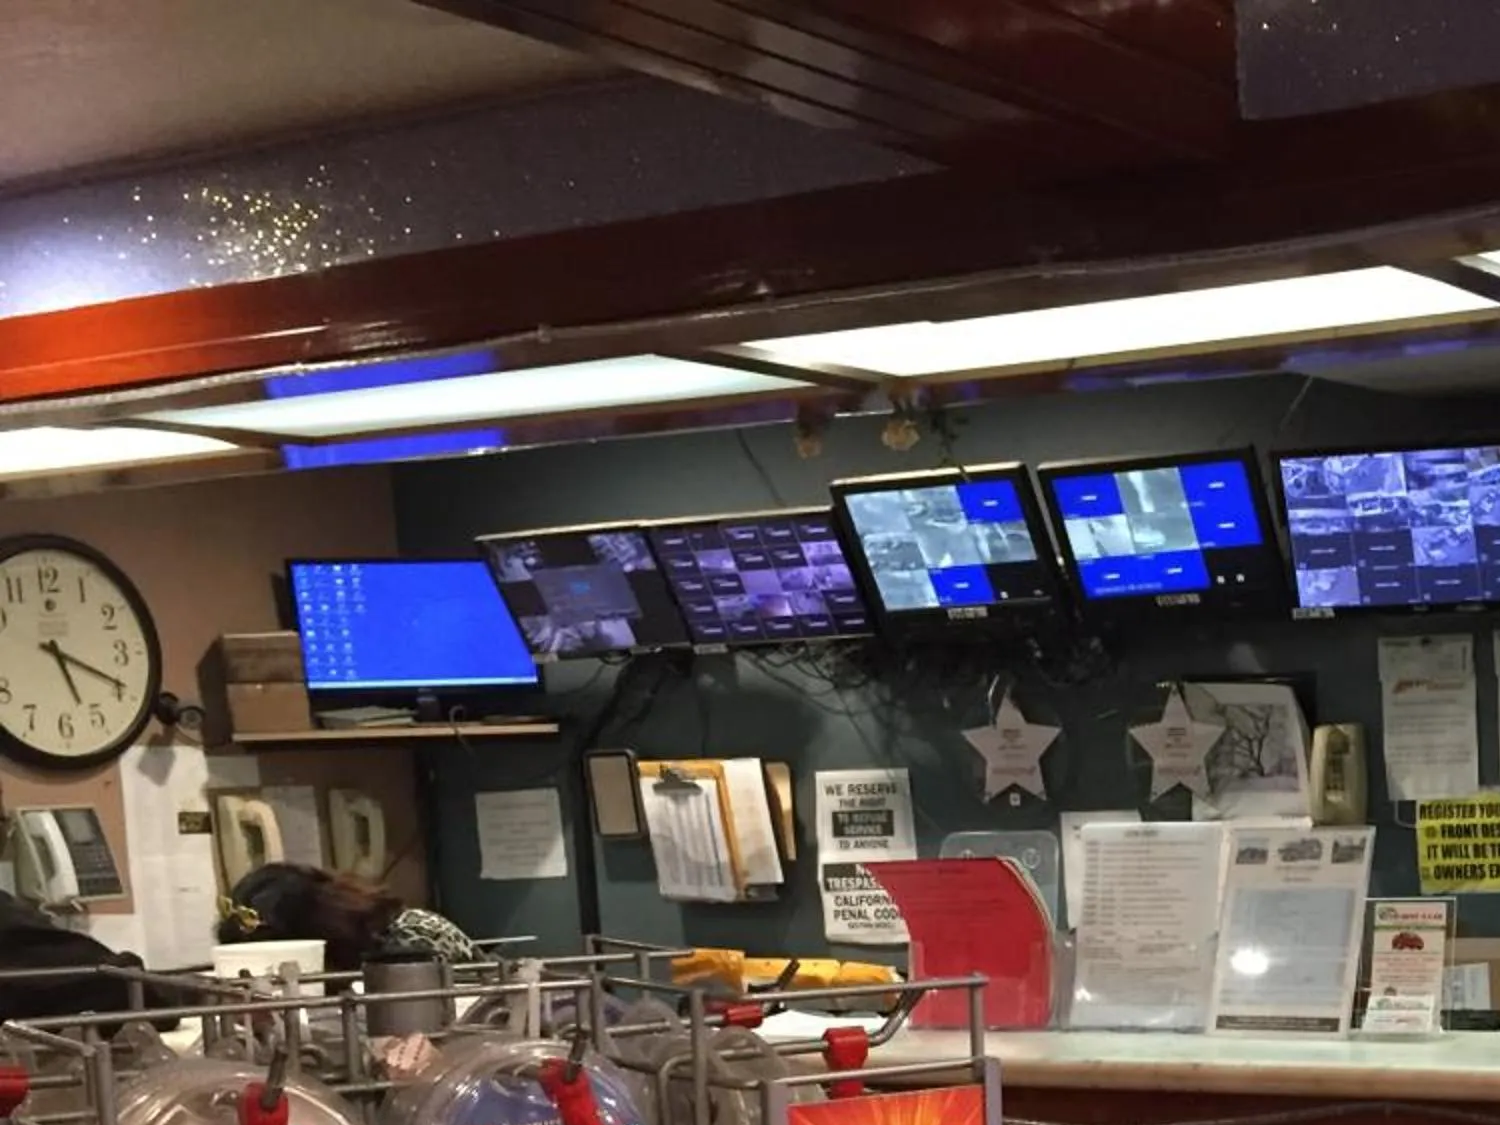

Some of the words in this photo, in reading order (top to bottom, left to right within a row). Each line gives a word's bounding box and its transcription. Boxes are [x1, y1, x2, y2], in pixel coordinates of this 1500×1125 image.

[37, 566, 61, 594] 12
[102, 603, 118, 630] 2
[114, 639, 129, 666] 3
[22, 704, 37, 731] 7
[58, 713, 74, 738] 6
[89, 703, 105, 729] 5
[825, 784, 843, 796] WE
[847, 782, 898, 796] RESERVE
[1419, 803, 1477, 821] REGISTER
[1440, 823, 1479, 839] FRONT
[839, 839, 850, 850] TO
[853, 838, 890, 850] ANYONE
[1427, 844, 1440, 861] IT
[1441, 844, 1472, 860] WILL
[1473, 844, 1489, 860] BE
[1433, 863, 1487, 881] OWNERS
[834, 909, 870, 921] PENAL
[873, 908, 899, 921] COD
